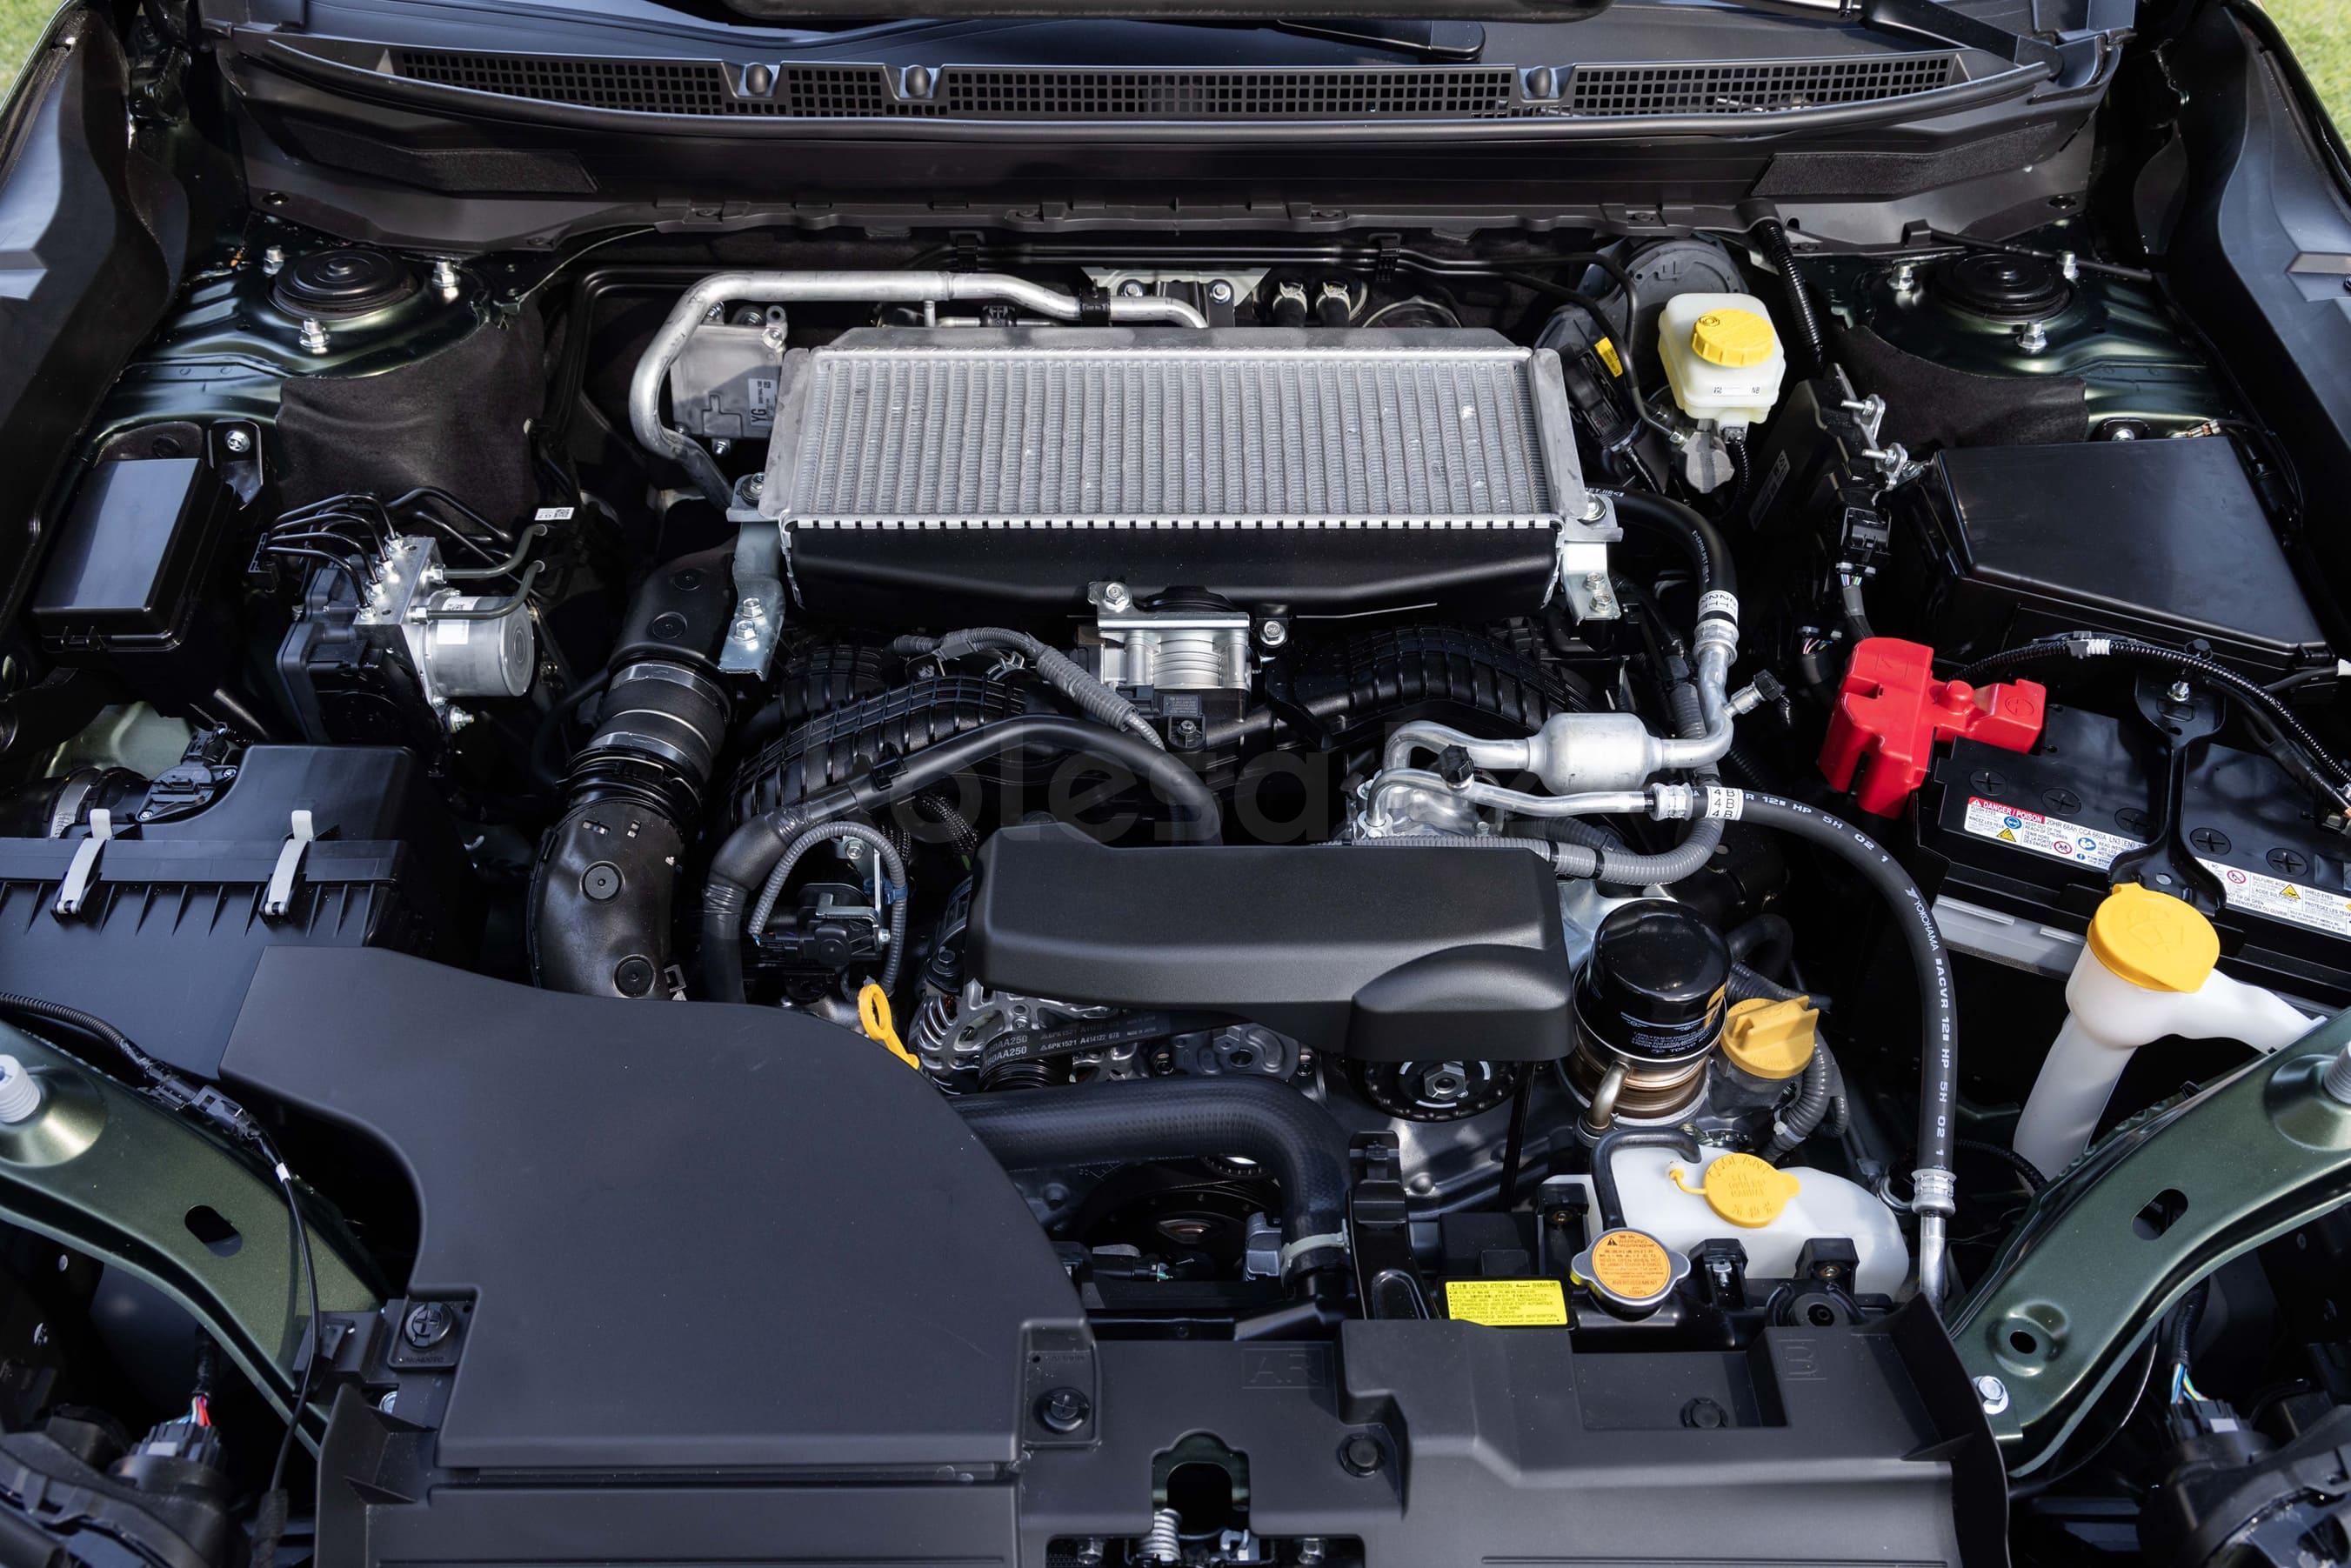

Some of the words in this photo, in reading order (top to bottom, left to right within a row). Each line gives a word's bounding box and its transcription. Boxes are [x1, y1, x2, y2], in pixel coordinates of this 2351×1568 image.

[1793, 804, 1813, 813] HP
[1983, 802, 2012, 816] DANGER
[2016, 811, 2042, 824] POISON
[1914, 900, 1940, 951] YOKOHAMA
[1941, 1048, 1950, 1069] HP
